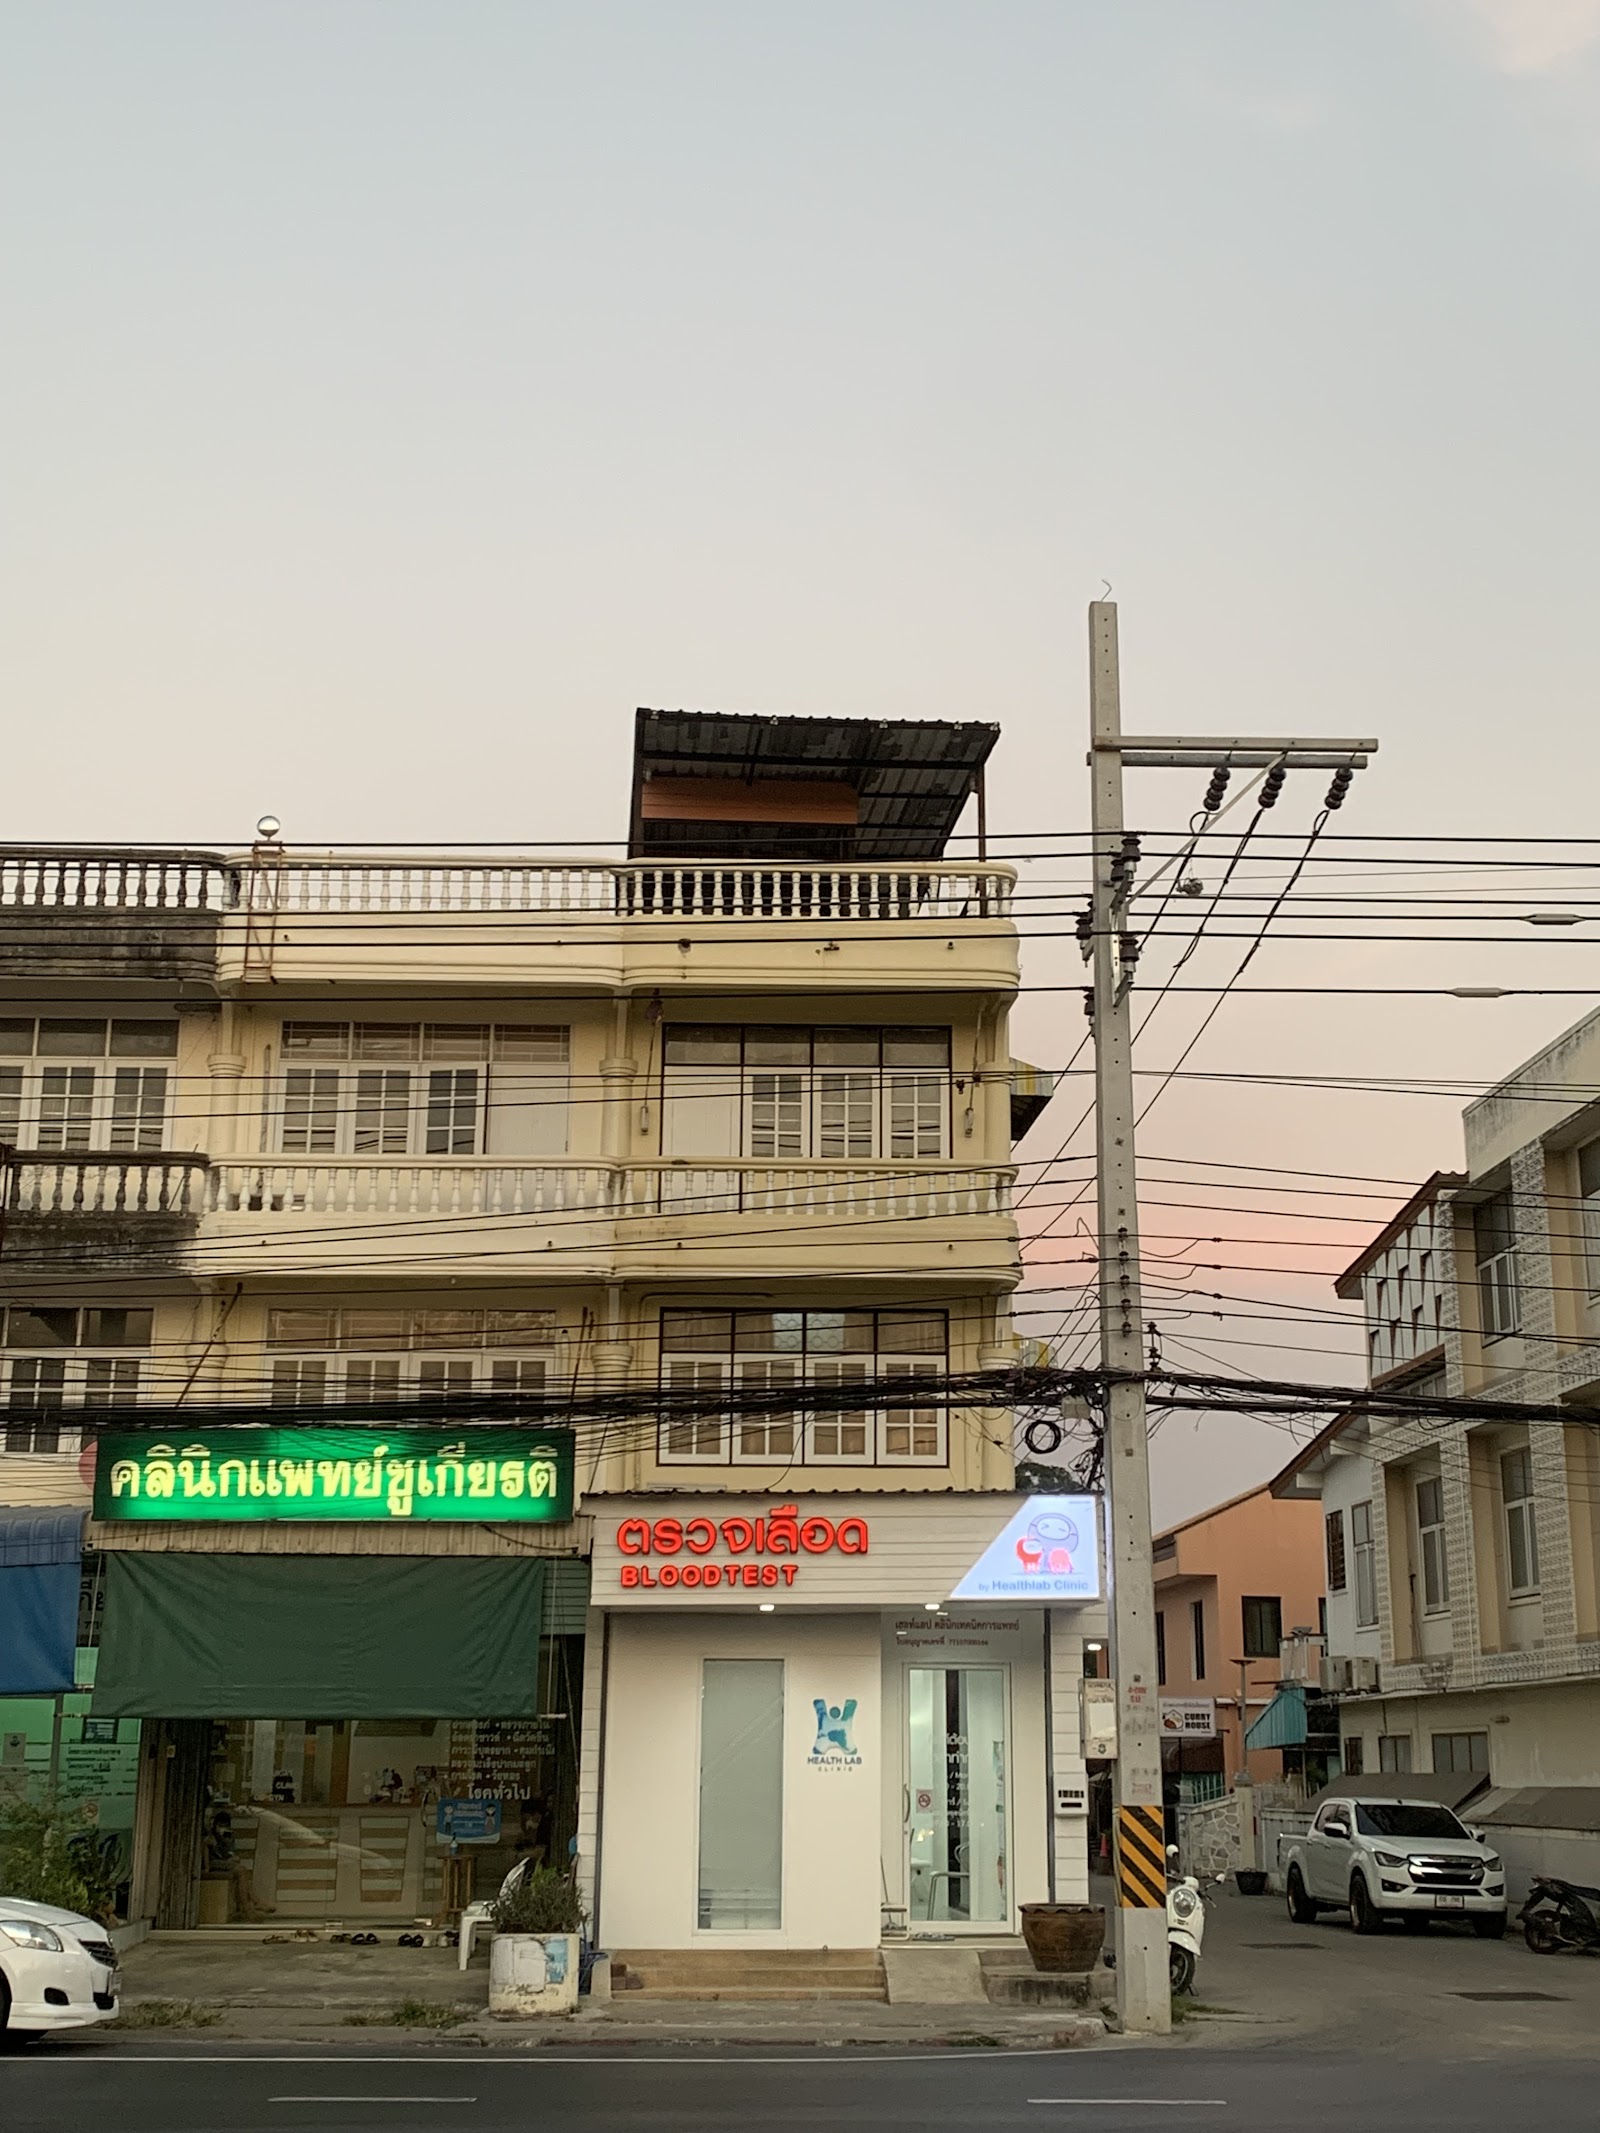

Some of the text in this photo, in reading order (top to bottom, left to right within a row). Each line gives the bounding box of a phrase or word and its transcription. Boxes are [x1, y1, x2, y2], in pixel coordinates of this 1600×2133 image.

[109, 1441, 558, 1516] คลินิกแพทย์ชูเกียรติ
[616, 1504, 868, 1555] ตรวจเลือด
[620, 1564, 799, 1588] BLOODTEST
[992, 1580, 1051, 1591] Healthlab
[1054, 1580, 1089, 1591] Clinic
[807, 1756, 862, 1765] HEALTH LAB
